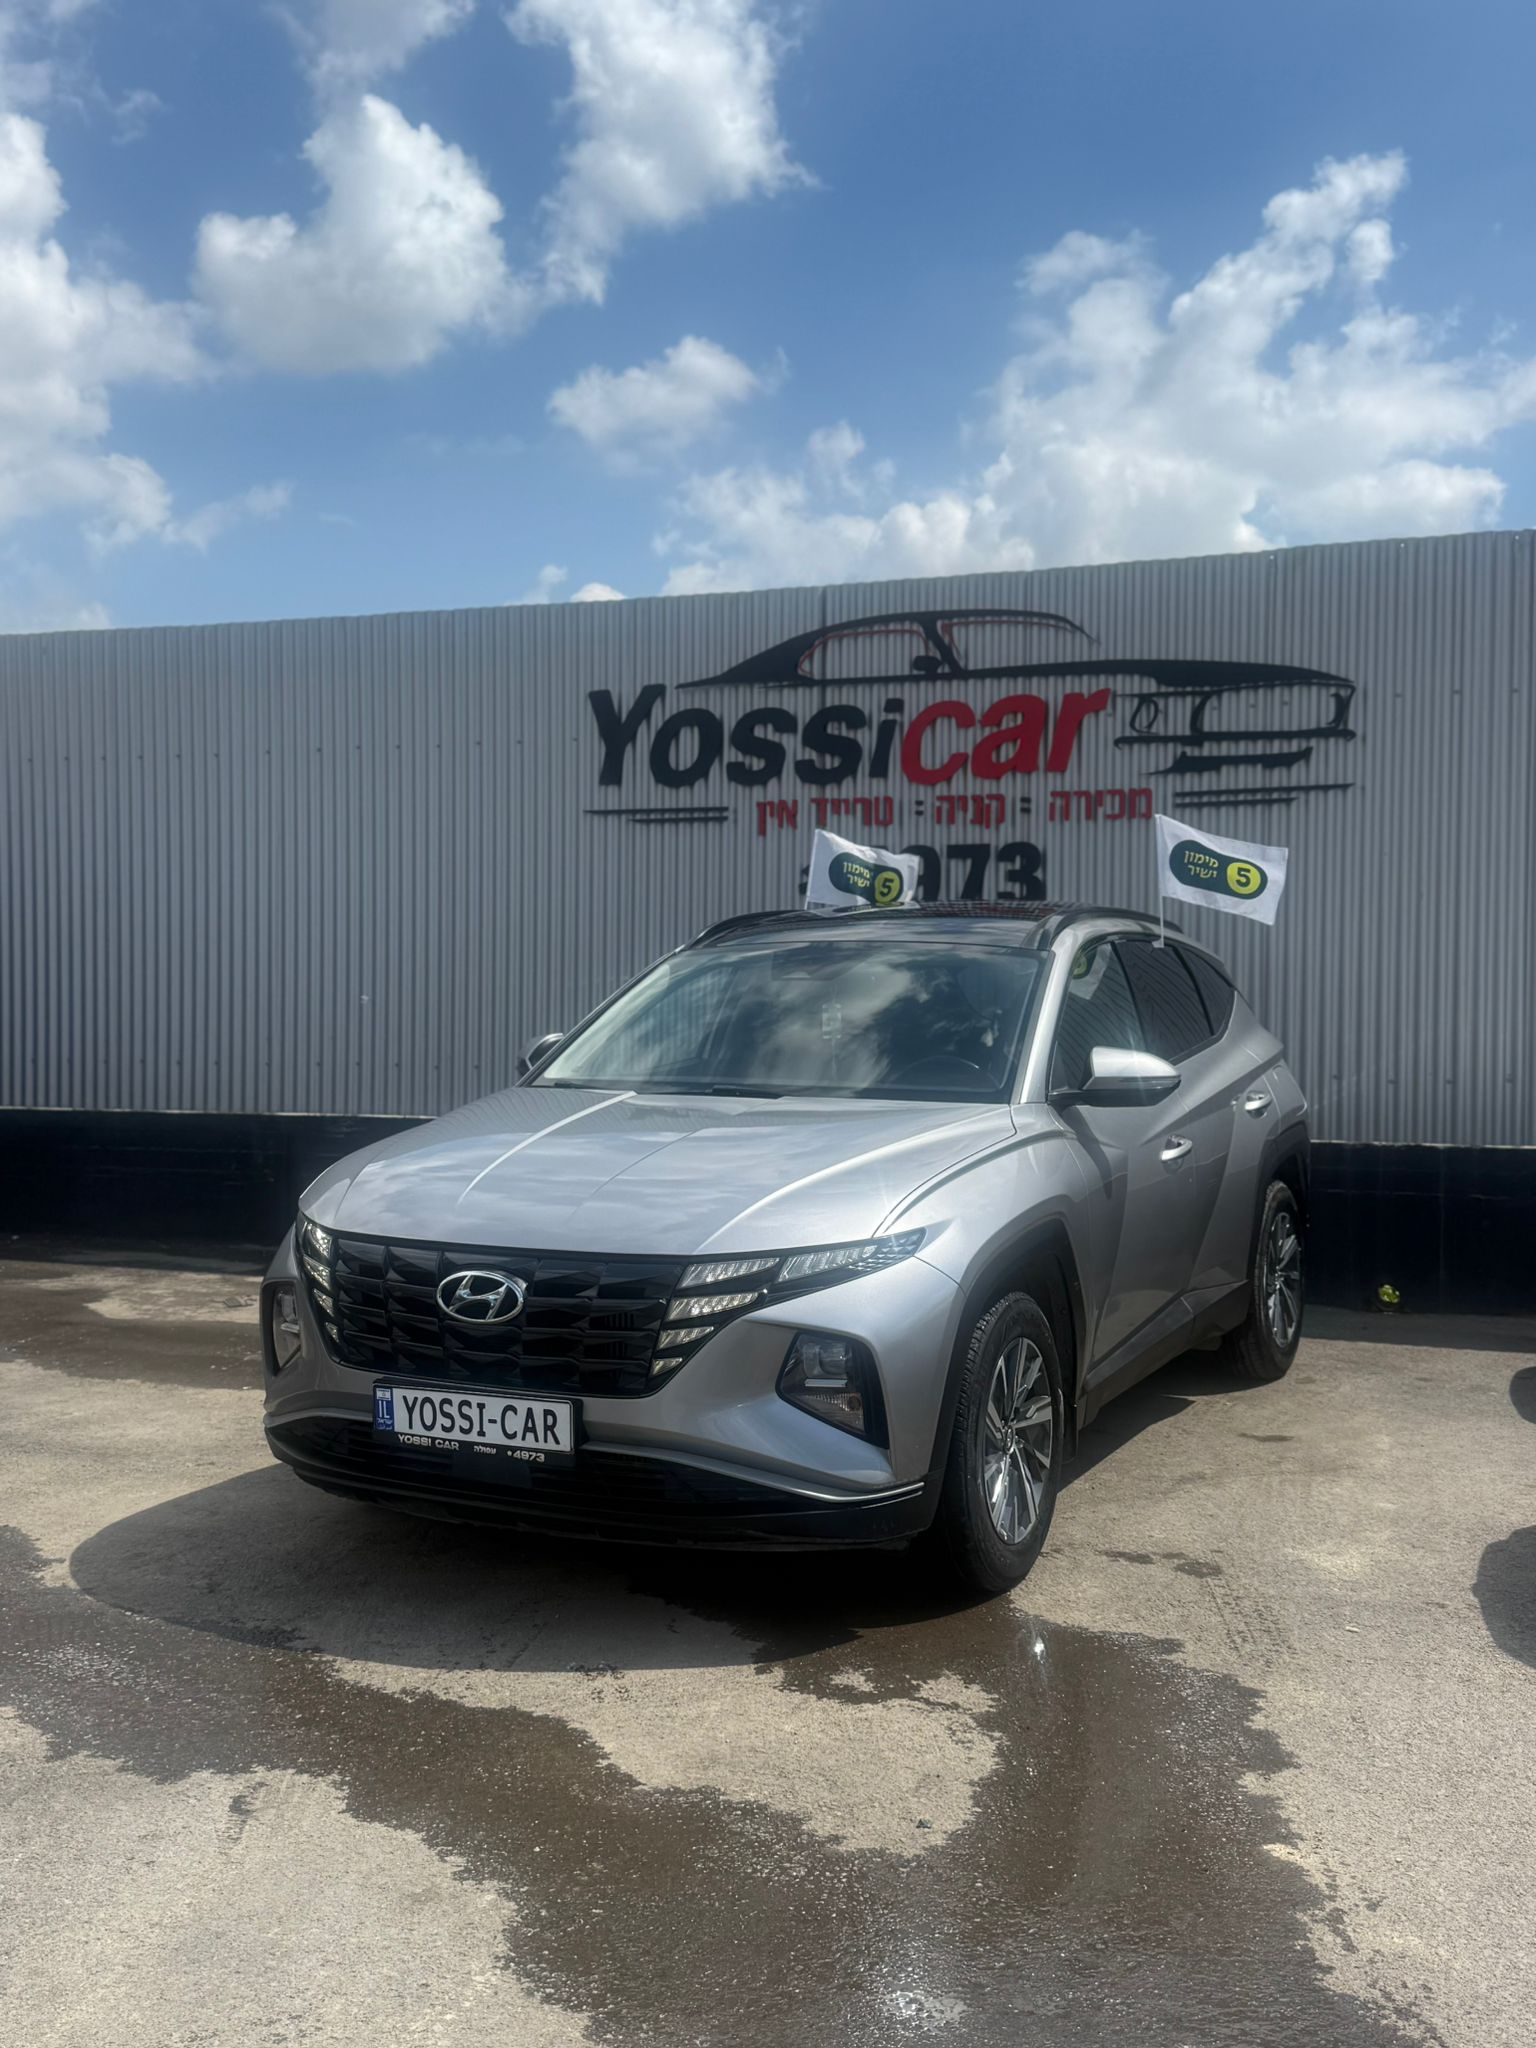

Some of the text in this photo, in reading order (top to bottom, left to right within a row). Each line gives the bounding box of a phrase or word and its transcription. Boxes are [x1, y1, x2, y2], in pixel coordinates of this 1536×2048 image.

[588, 683, 1112, 789] Yossicar
[935, 793, 1006, 830] קניה
[1049, 788, 1153, 822] מכירה
[756, 799, 799, 838] אין
[843, 861, 871, 878] מימון
[1184, 850, 1219, 868] מימון
[847, 874, 870, 887] ישיר
[1188, 865, 1217, 878] ישיר
[1235, 867, 1252, 888] 5
[879, 877, 894, 898] 5
[378, 1400, 390, 1419] IL
[402, 1395, 560, 1445] YOSSI-CAR
[398, 1433, 459, 1450] YOSSI CAR
